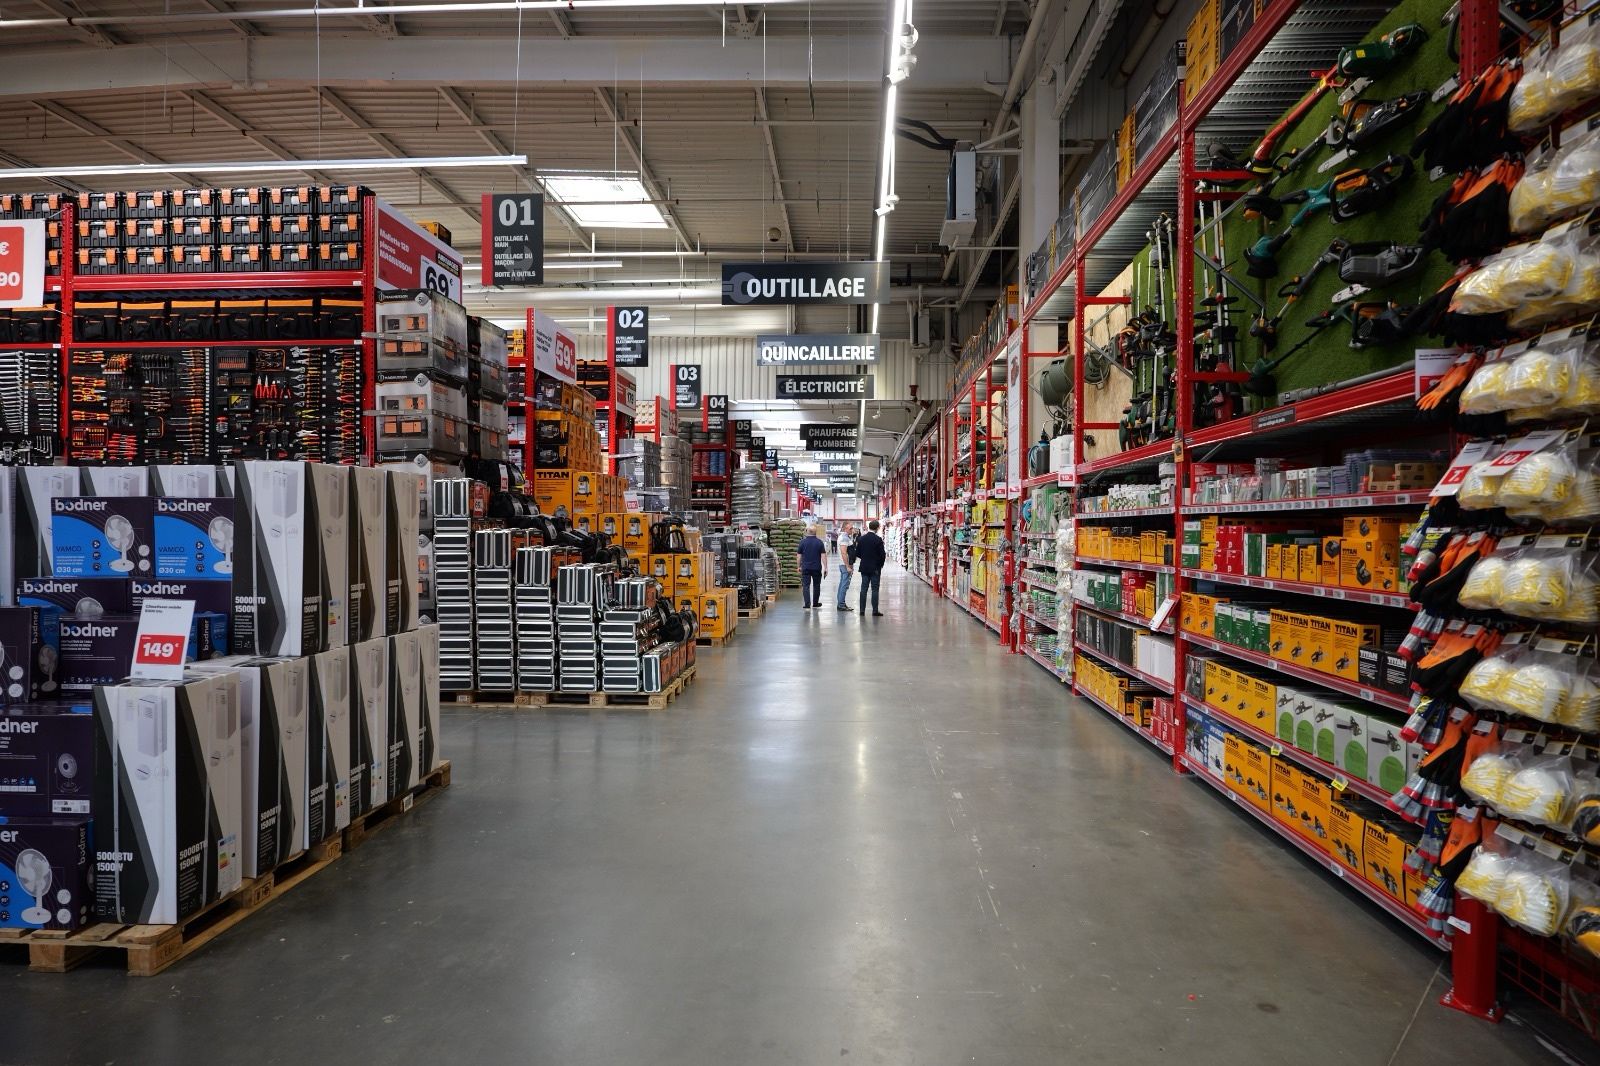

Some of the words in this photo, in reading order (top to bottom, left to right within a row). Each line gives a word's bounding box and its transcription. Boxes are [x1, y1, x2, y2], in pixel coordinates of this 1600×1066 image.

[499, 199, 535, 226] 01
[746, 277, 866, 298] OUTILLAGE
[619, 310, 644, 328] 02
[762, 346, 875, 361] QUINCAILLERIE
[679, 367, 698, 380] 03
[785, 379, 865, 393] ÉLECTRICITÉ
[710, 397, 725, 408] 04
[737, 422, 750, 430] 05
[808, 428, 857, 436] CHAUFFAGE
[753, 438, 764, 446] 06
[55, 499, 107, 511] bodner
[158, 499, 211, 511] bodner
[24, 581, 78, 593] bodner
[132, 581, 186, 594] bodner
[1271, 612, 1289, 623] TITAN
[1290, 616, 1309, 627] TITAN
[60, 623, 118, 637] bodner
[1311, 619, 1331, 631] TITAN
[1335, 624, 1358, 636] TITAN
[143, 642, 173, 657] 149
[1360, 650, 1378, 662] TITAN
[1387, 656, 1407, 669] TITAN
[1248, 750, 1261, 763] TITAN
[1275, 763, 1291, 777] TITAN
[1303, 779, 1320, 796] TITAN
[1330, 805, 1349, 822] TITAN
[1366, 825, 1388, 844] TITAN
[97, 852, 133, 861] 5000BTU
[180, 853, 201, 870] 1500W
